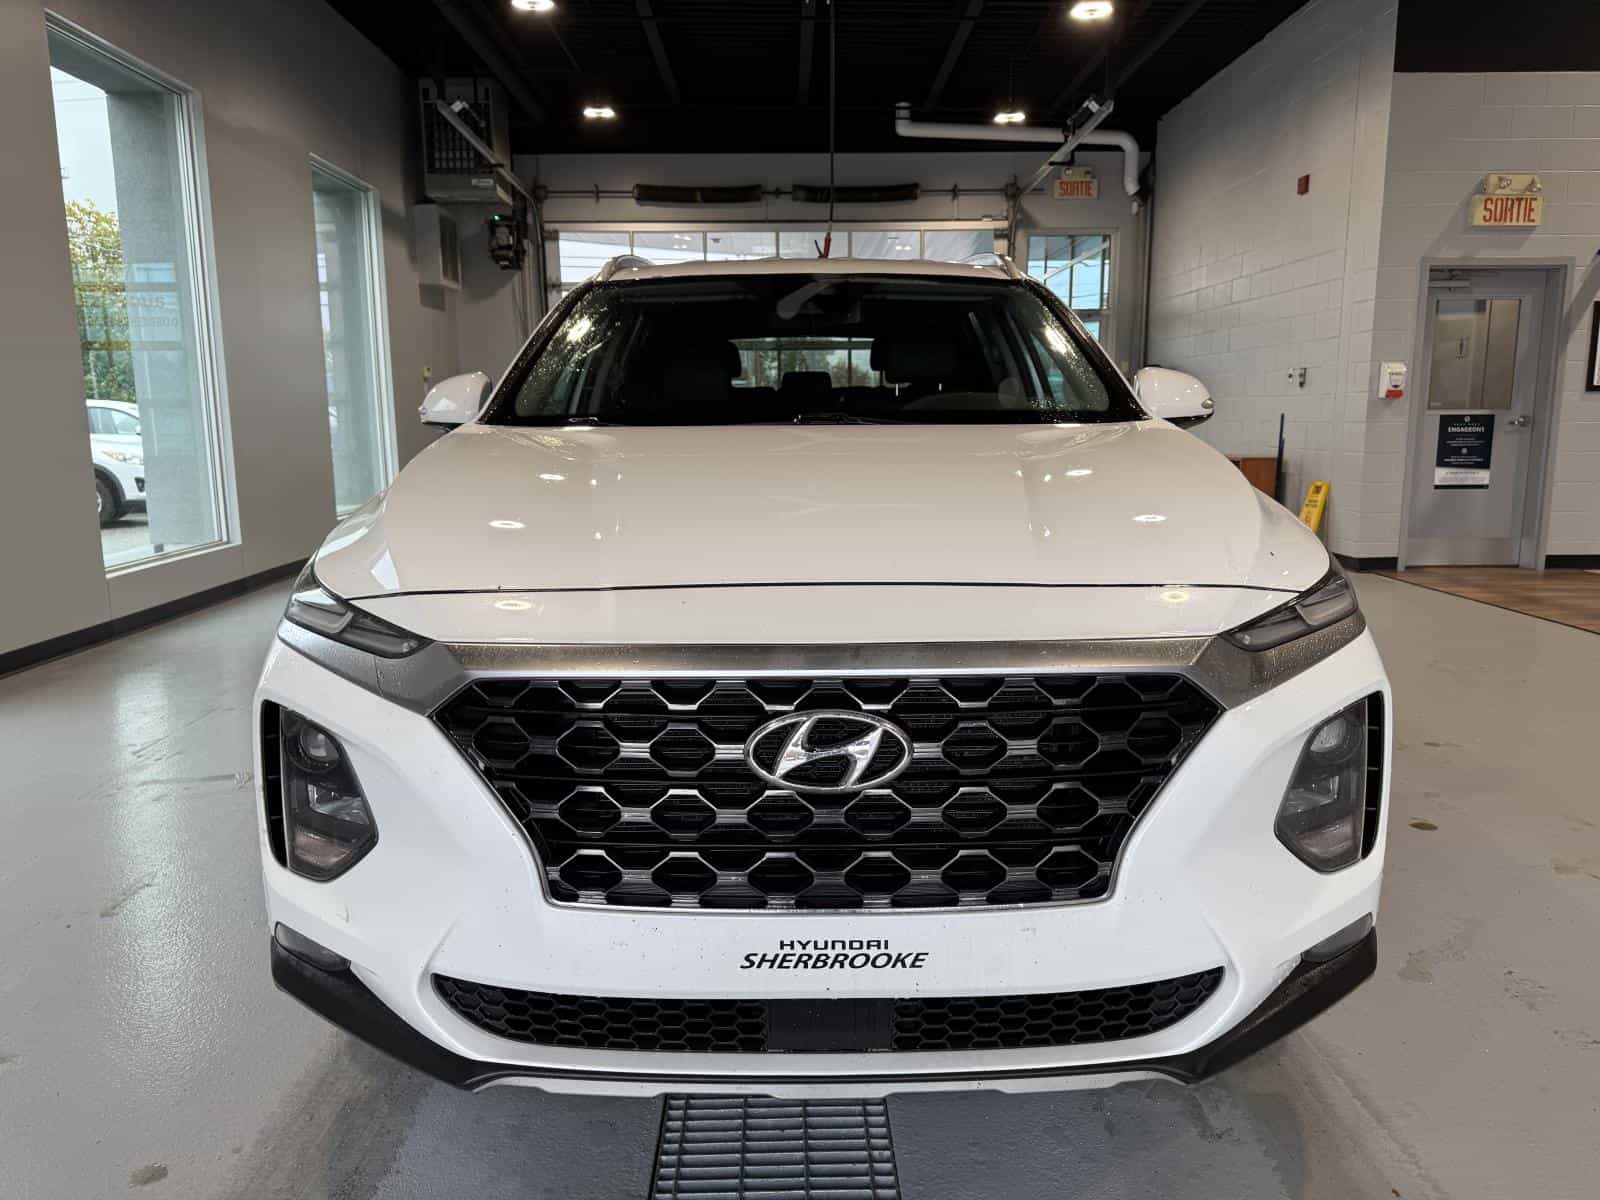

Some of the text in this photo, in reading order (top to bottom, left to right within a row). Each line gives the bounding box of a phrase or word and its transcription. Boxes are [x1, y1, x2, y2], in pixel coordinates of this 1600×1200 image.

[1059, 181, 1094, 197] SORTIE
[1482, 196, 1538, 224] SORTIE
[779, 940, 889, 950] HYUNDAI
[740, 952, 929, 969] SHERBROOKE
